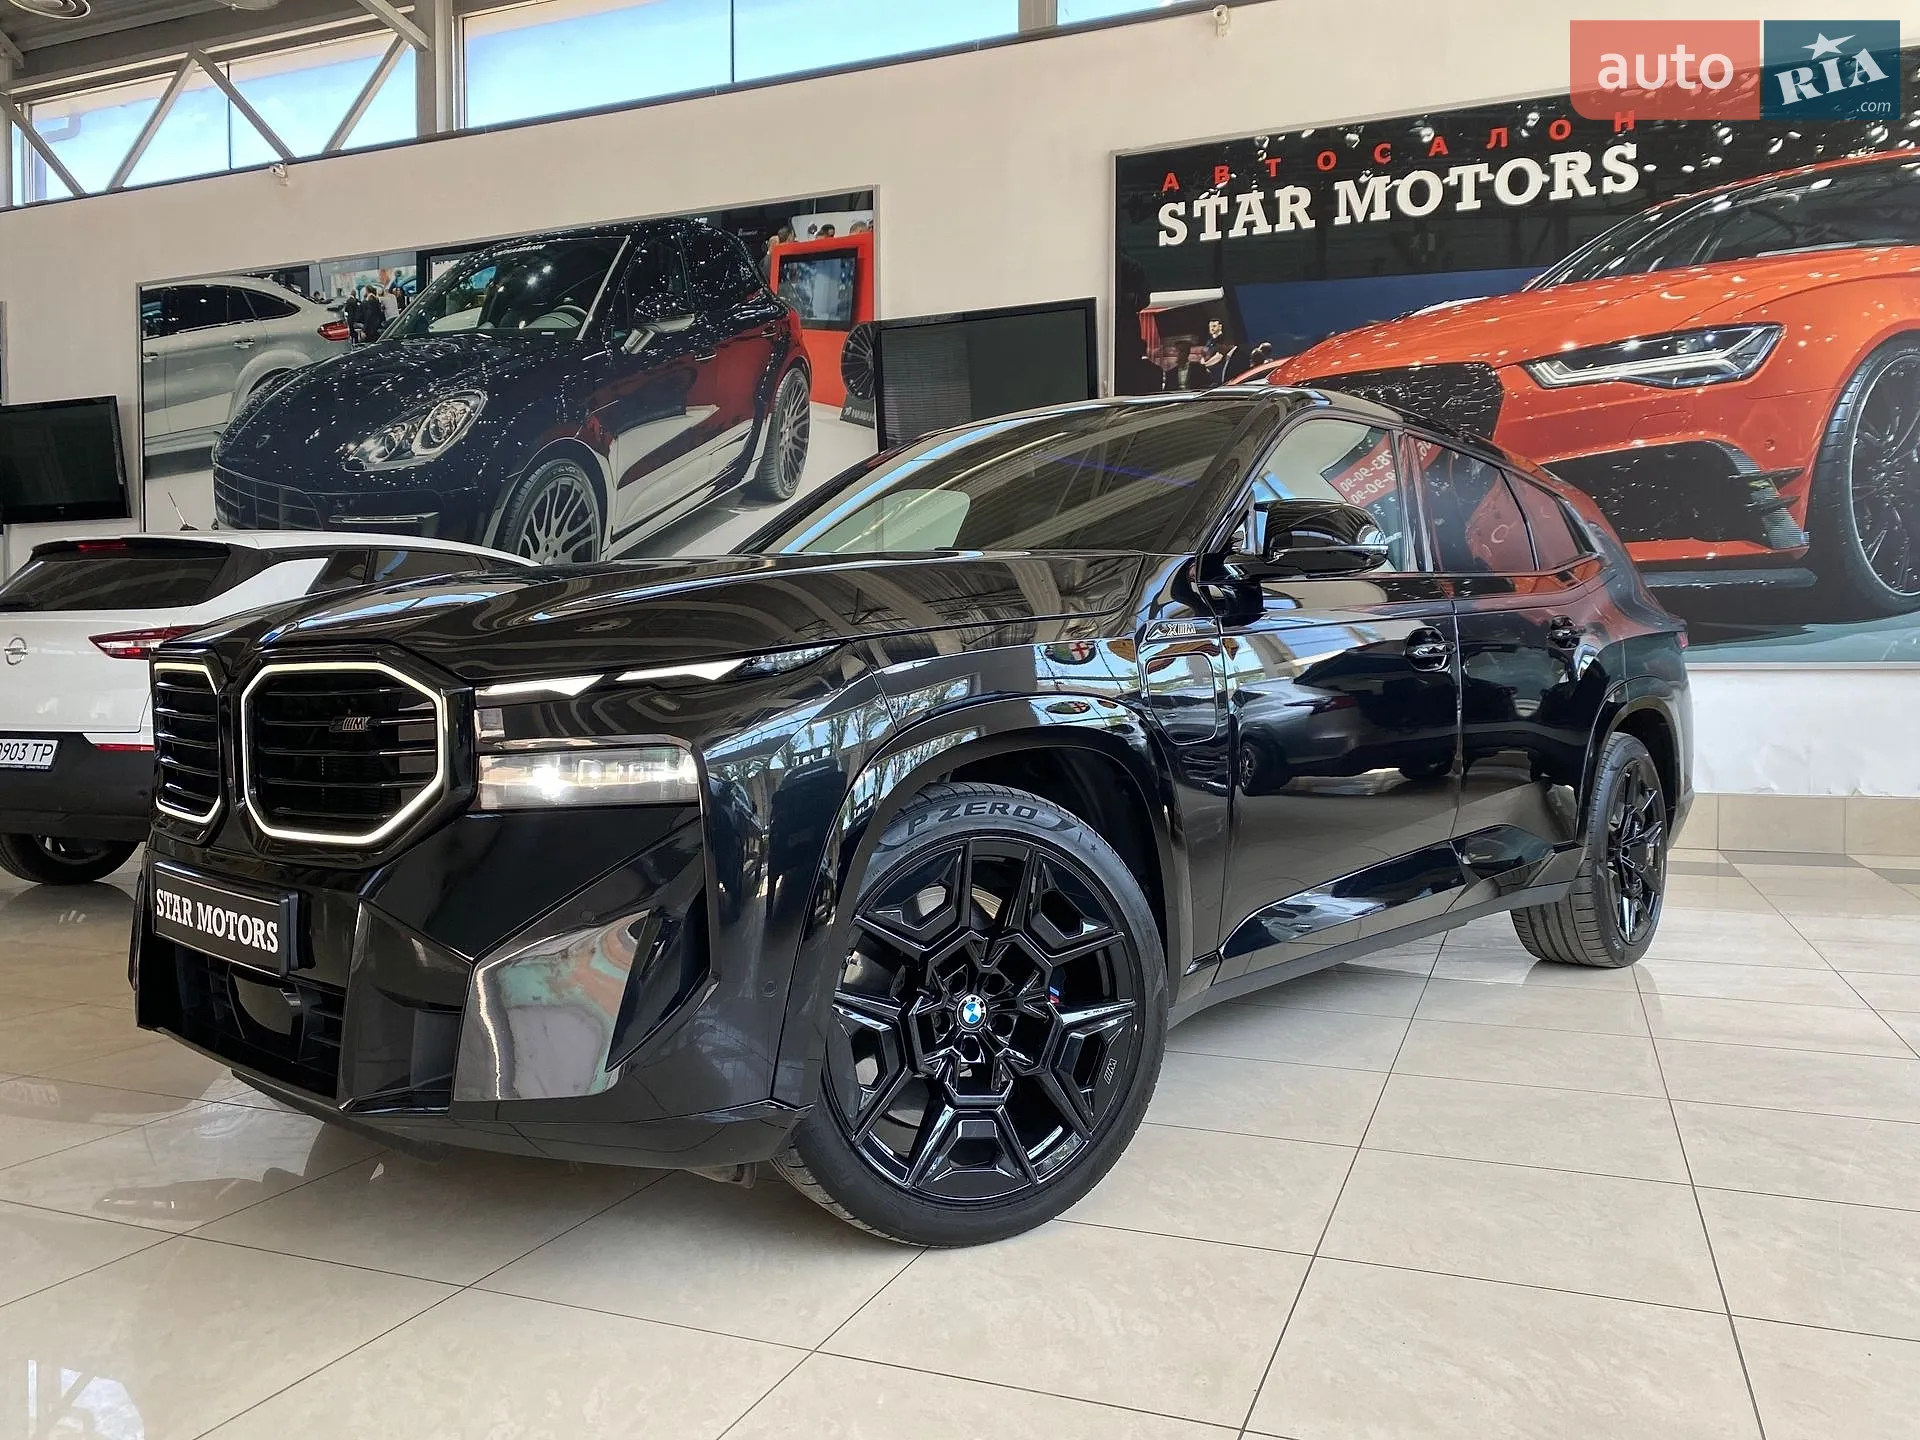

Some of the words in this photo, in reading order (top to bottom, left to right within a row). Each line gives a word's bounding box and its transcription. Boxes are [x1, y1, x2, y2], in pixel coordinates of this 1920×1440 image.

[1158, 184, 1316, 246] STAR
[1334, 142, 1640, 225] MOTORS
[0, 743, 29, 760] 903
[32, 744, 53, 762] TP
[908, 813, 929, 836] P
[938, 802, 1039, 822] ZERO
[156, 888, 194, 928] STAR
[196, 901, 279, 954] MOTORS
